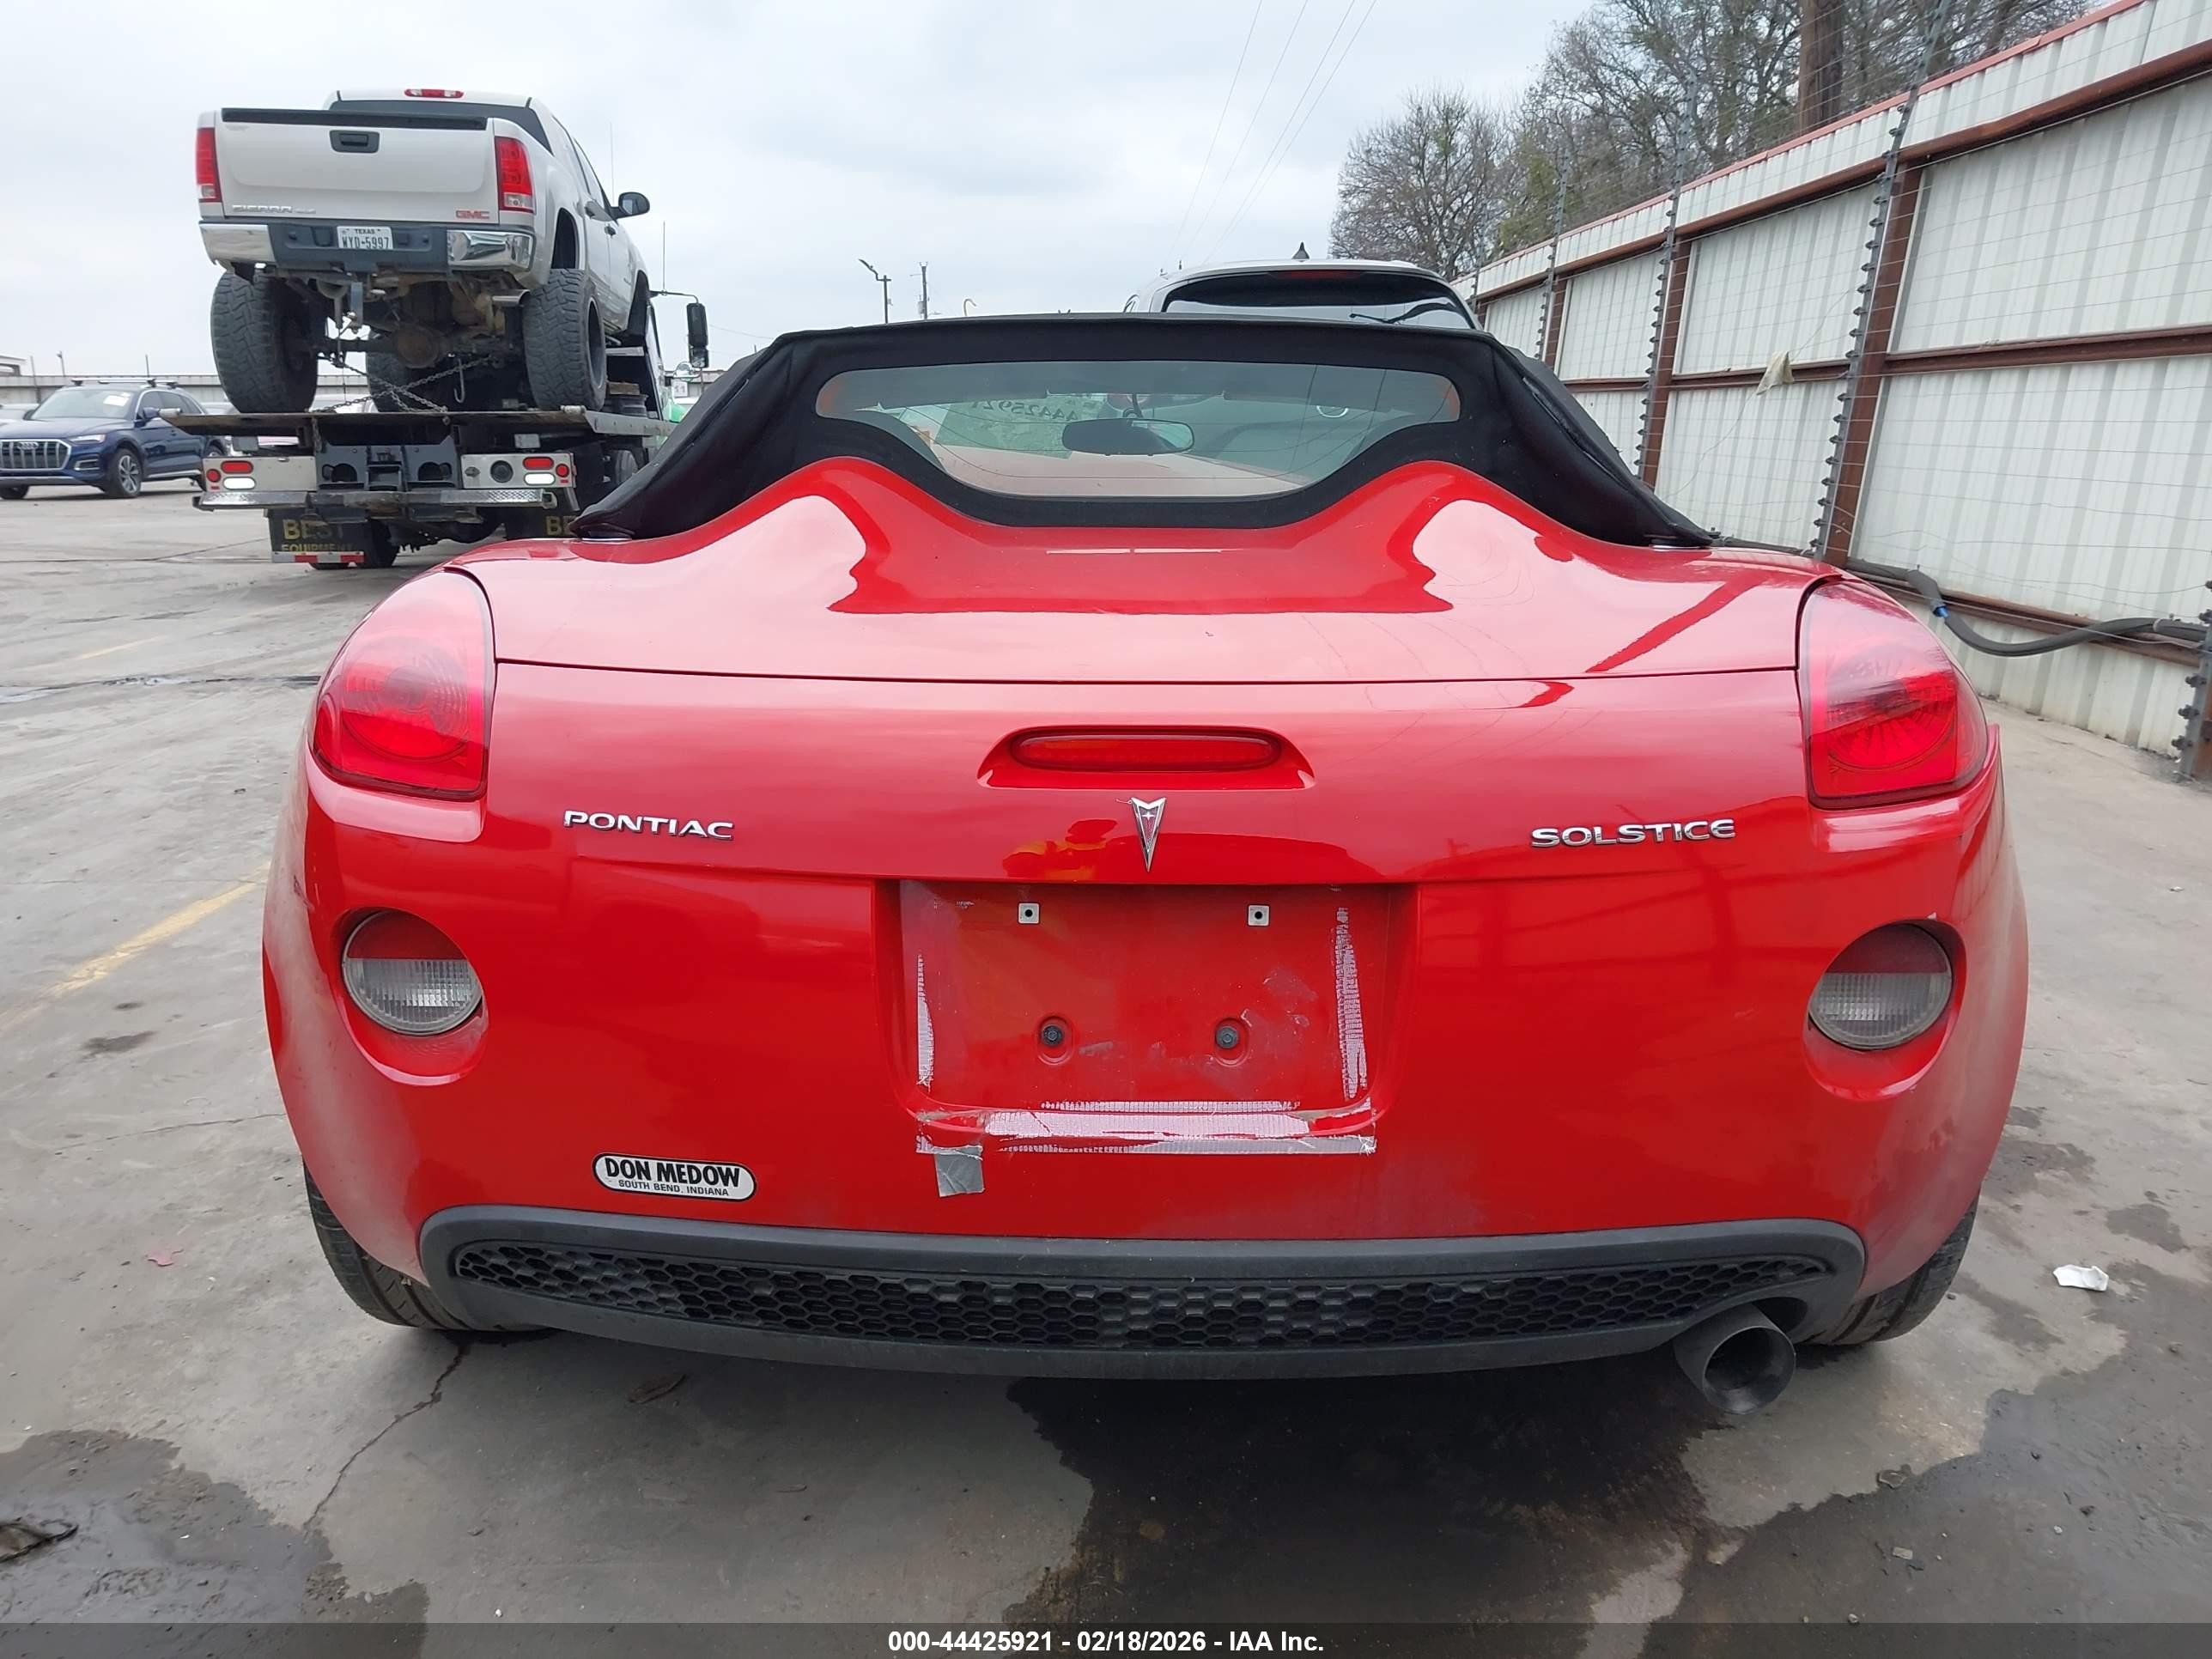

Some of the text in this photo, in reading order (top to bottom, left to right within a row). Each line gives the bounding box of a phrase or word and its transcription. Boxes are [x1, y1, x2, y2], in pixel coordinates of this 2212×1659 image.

[455, 210, 490, 220] GMC
[563, 810, 734, 841] PONTIAC
[1531, 818, 1736, 848] SOLSTICE
[605, 1158, 740, 1188] DON MEDOW
[618, 1180, 650, 1190] SOUTH
[687, 1187, 729, 1196] INDIANA
